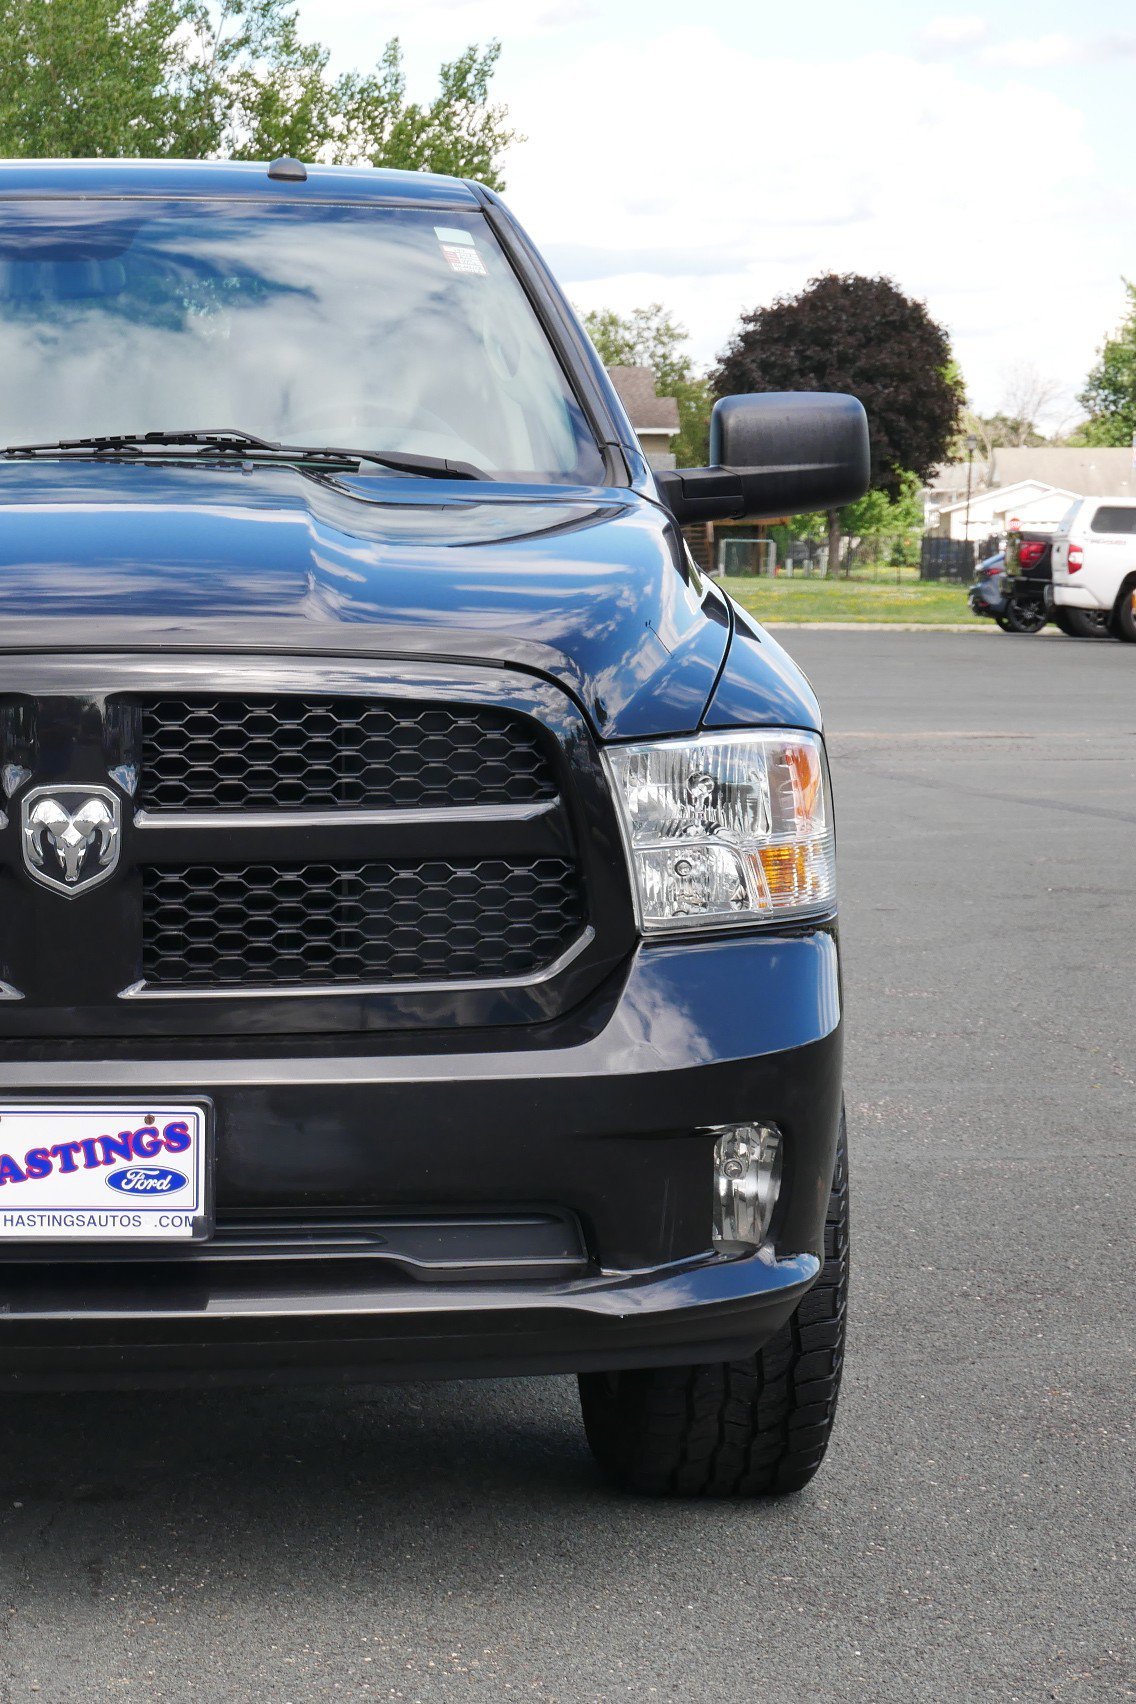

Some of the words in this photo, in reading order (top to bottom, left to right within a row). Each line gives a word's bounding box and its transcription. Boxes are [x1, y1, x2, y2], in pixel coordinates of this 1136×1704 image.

[121, 1168, 173, 1191] Ford
[3, 1214, 142, 1227] HASTINGSAUTOS
[154, 1214, 195, 1228] .COM
